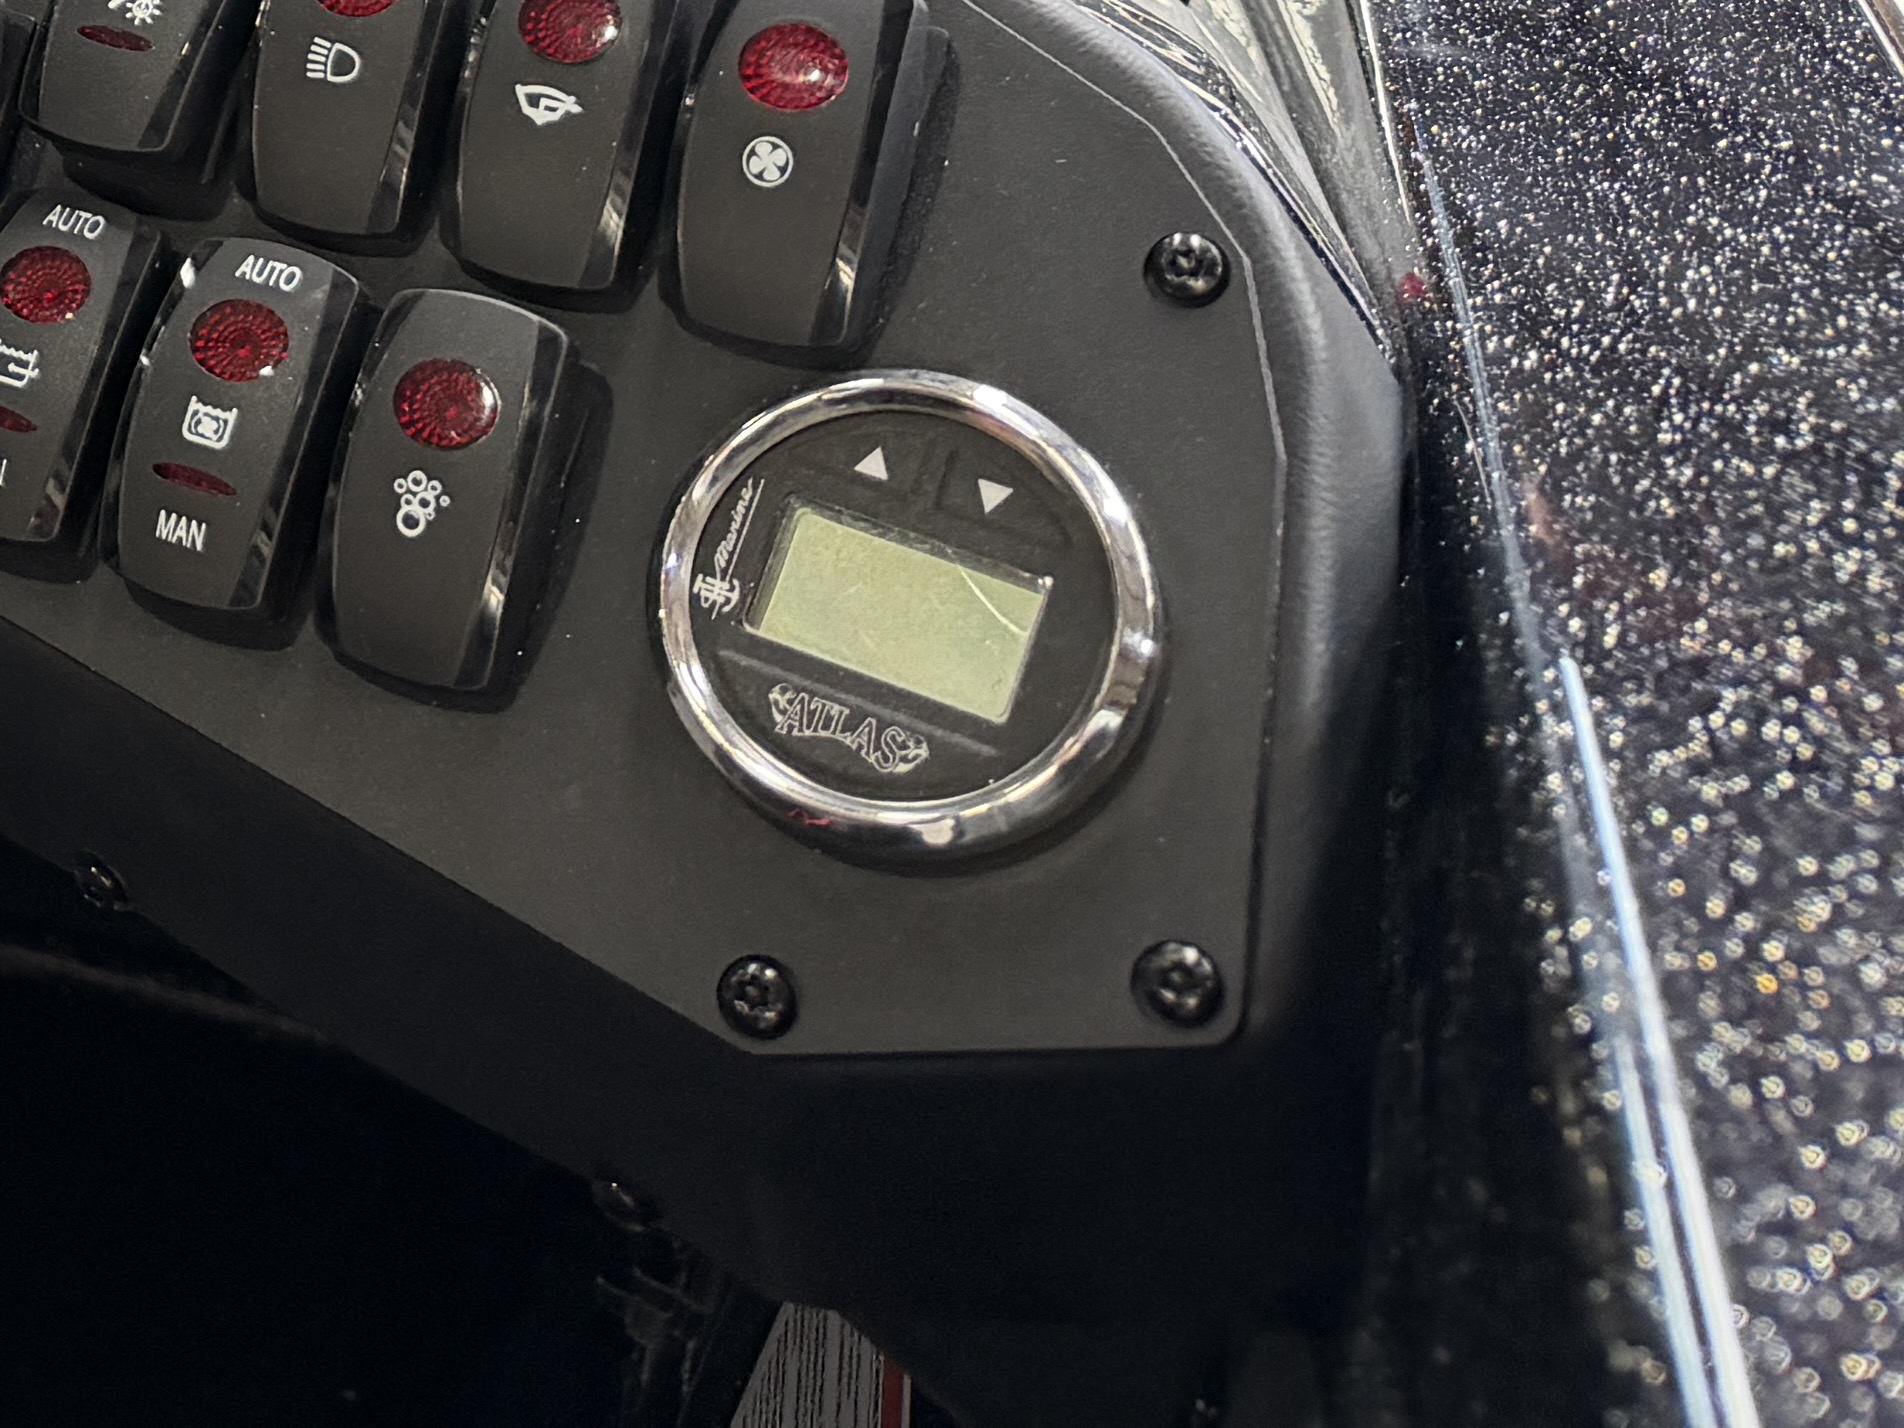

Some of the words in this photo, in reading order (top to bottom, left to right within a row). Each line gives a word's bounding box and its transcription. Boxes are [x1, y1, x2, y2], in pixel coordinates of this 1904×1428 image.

[43, 204, 106, 239] AUTO
[235, 254, 304, 292] AUTO
[155, 509, 207, 552] MAN
[774, 691, 914, 774] ATLAS
